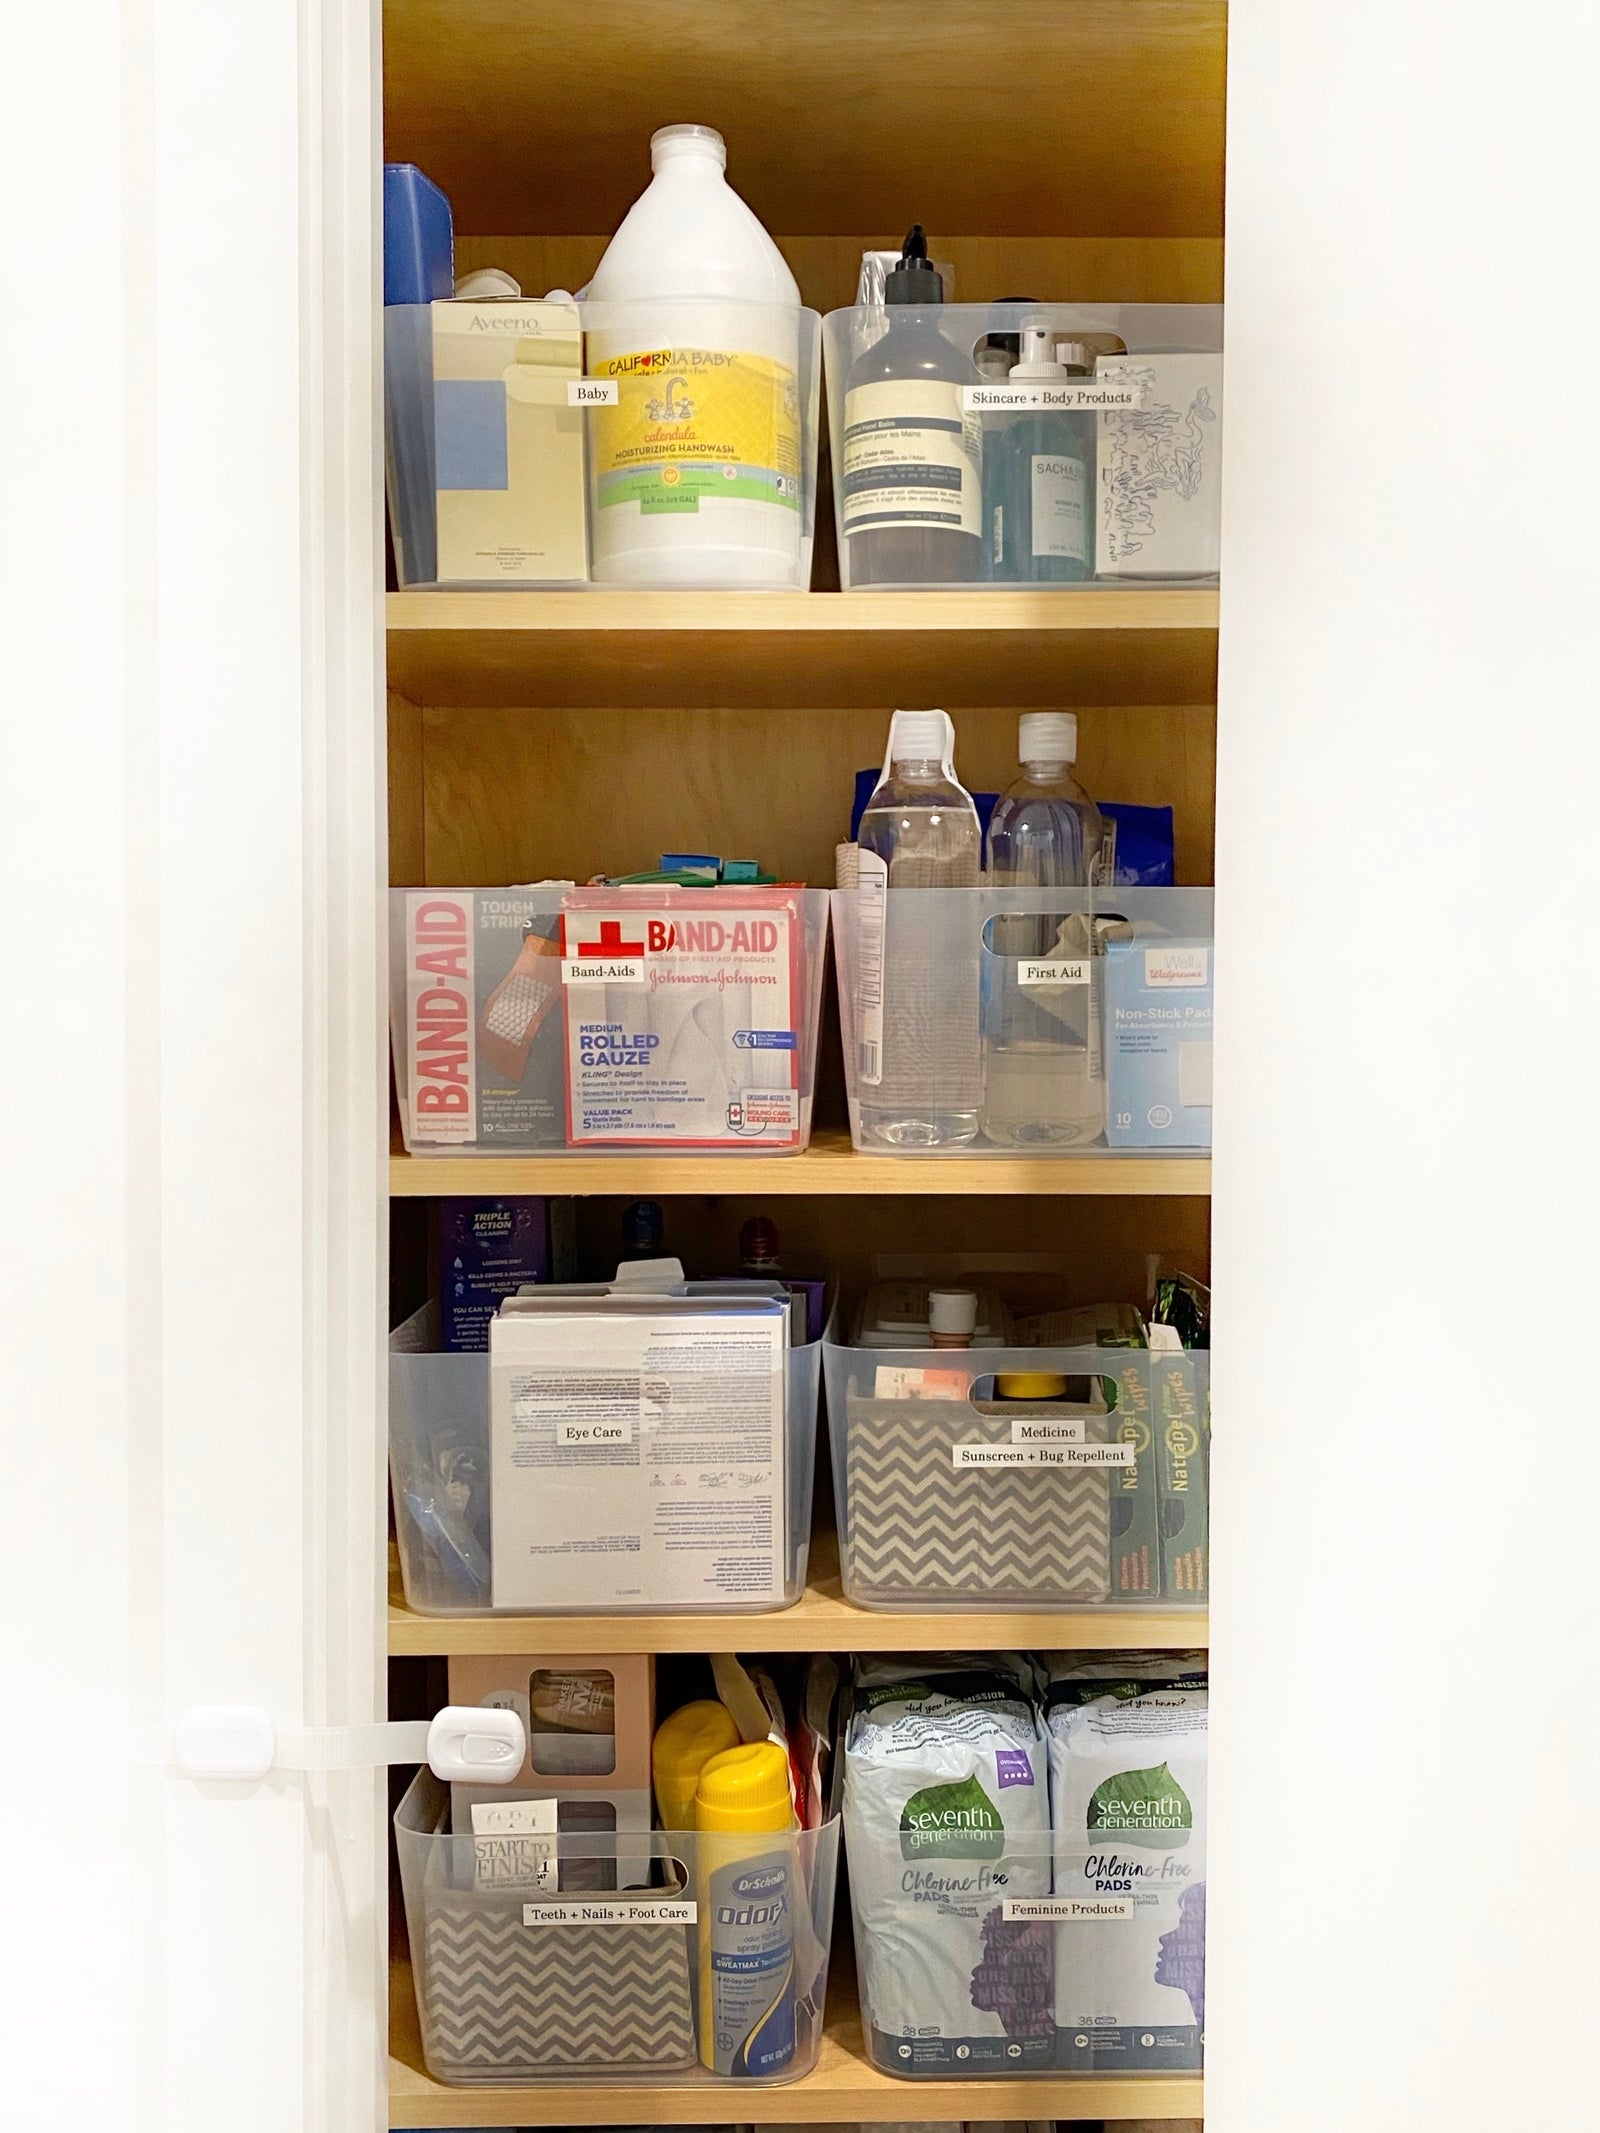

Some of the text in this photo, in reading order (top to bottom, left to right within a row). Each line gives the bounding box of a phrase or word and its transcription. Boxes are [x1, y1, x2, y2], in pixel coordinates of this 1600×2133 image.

[469, 314, 541, 331] Aveeno
[691, 352, 734, 367] BABY
[577, 386, 609, 402] Baby
[972, 392, 1027, 404] Skincare
[1042, 392, 1074, 406] Body
[1077, 392, 1132, 404] Products
[644, 426, 697, 443] calendula
[615, 444, 735, 460] MOISTURIZING HANDWASH
[481, 901, 534, 915] TOUGH
[480, 915, 533, 929] STRIPS
[648, 920, 778, 953] BAND-AID
[1164, 955, 1194, 969] Well
[571, 965, 635, 977] Band-Aids
[1027, 966, 1082, 978] First Aid
[1149, 969, 1203, 983] Walgreens
[416, 901, 469, 1113] BAND-AID
[1115, 1007, 1182, 1020] Non-Stick
[580, 1024, 622, 1033] MEDIUM
[580, 1034, 660, 1050] ROLLED
[580, 1051, 651, 1066] GAUZE
[614, 1070, 643, 1079] Design
[611, 1108, 633, 1116] PACK
[1115, 1112, 1131, 1125] 10
[482, 1123, 494, 1133] 10
[583, 1118, 591, 1129] 5
[474, 1212, 511, 1222] TRIPLE
[473, 1220, 512, 1231] ACTION
[1122, 1366, 1149, 1411] wipes
[1167, 1371, 1195, 1416] wipes
[566, 1426, 622, 1440] Eye Care
[1021, 1426, 1076, 1438] Medicine
[961, 1450, 1126, 1463] Sunscreen + Bug Repellent
[1119, 1410, 1140, 1490] Naapel
[1167, 1413, 1189, 1492] Natrapel
[905, 1702, 923, 1713] did
[924, 1703, 942, 1714] you
[1135, 1700, 1153, 1708] you
[1155, 1697, 1186, 1707] know?
[1097, 1796, 1182, 1816] seventh
[908, 1808, 993, 1831] seventh
[1097, 1816, 1181, 1830] generation
[910, 1826, 994, 1849] generation
[476, 1840, 550, 1859] START TO
[1085, 1855, 1192, 1880] Chlorine-Free
[901, 1866, 1009, 1892] Chlorine-Free
[1095, 1880, 1132, 1891] PADS
[914, 1892, 950, 1904] PADS
[531, 1909, 567, 1920] Teeth
[582, 1908, 614, 1919] Nails
[629, 1908, 656, 1919] Foot
[659, 1907, 688, 1918] Care
[1011, 1903, 1125, 1915] Feminine Products
[737, 1944, 760, 1953] spray
[716, 1960, 759, 1969] SWEATMAX
[1078, 2016, 1093, 2026] 36
[902, 2025, 916, 2036] 28
